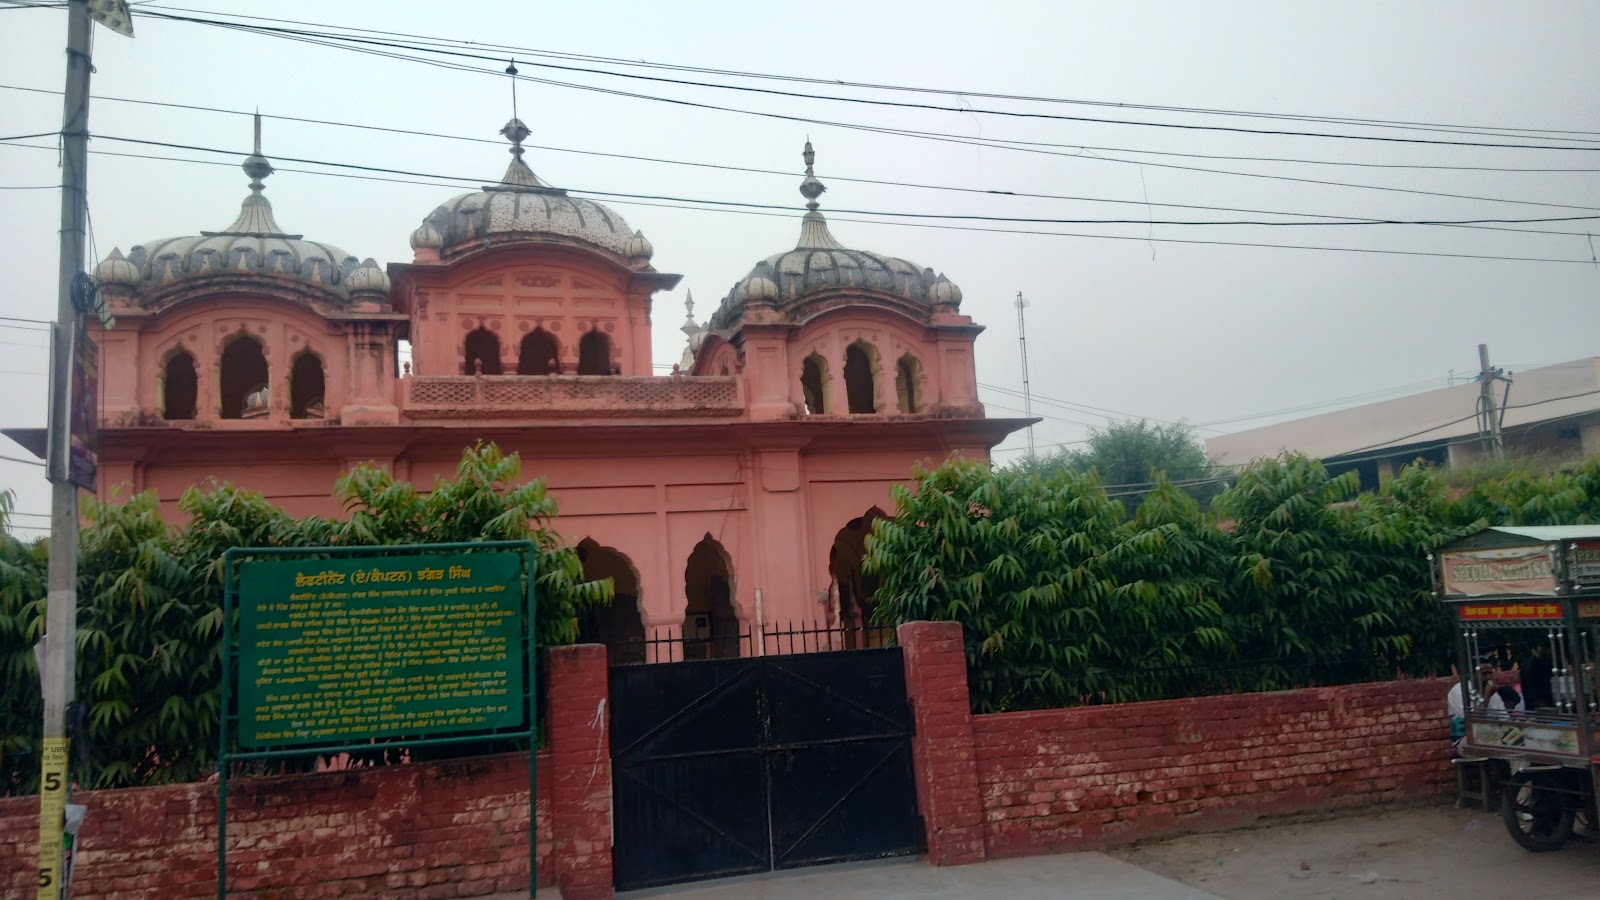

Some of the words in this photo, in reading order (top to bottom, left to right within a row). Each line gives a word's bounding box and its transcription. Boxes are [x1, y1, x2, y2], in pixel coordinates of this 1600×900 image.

[449, 565, 472, 580] ਸਿੰਘ
[1453, 564, 1494, 582] SPECIAL
[1498, 561, 1551, 581] AMRITSA
[44, 772, 61, 791] 5
[38, 868, 52, 888] 5
